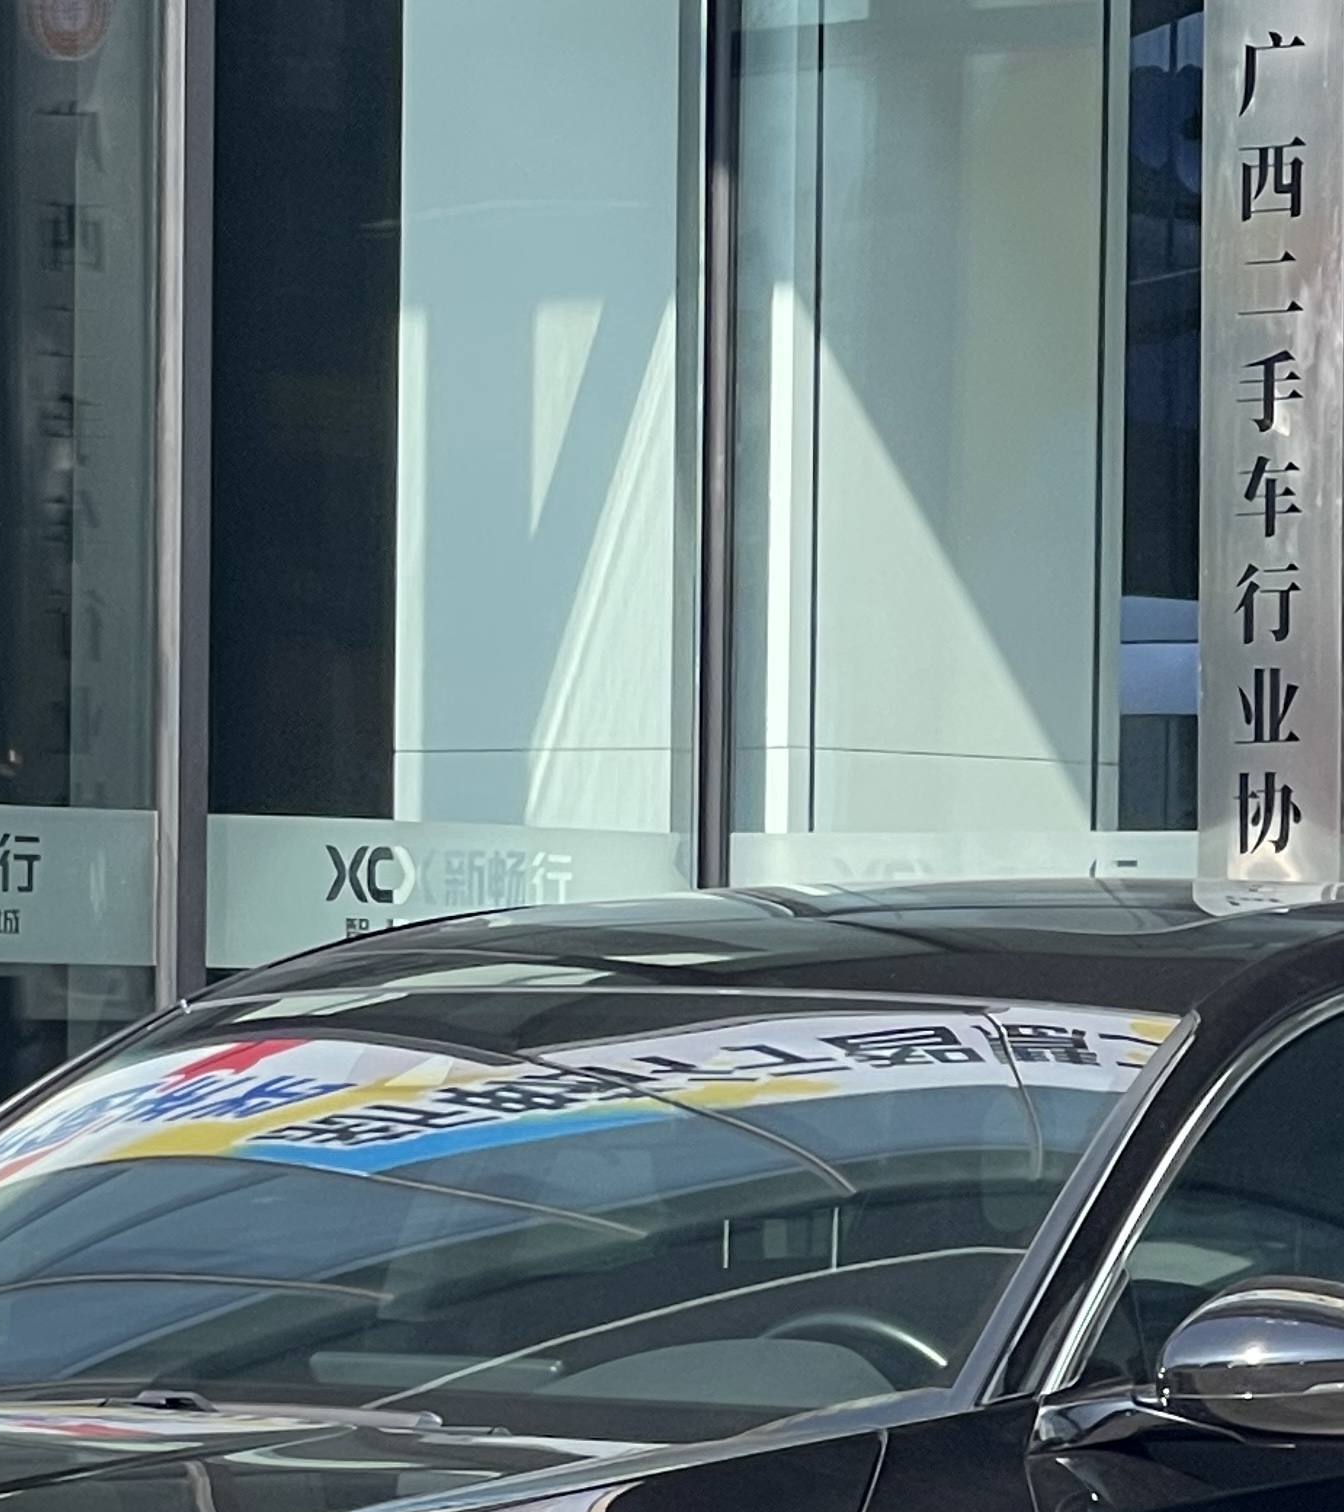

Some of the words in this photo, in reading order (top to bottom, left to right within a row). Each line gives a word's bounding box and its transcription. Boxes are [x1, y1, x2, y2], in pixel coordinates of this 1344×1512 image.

[1232, 31, 1307, 855] 广西二手车行业协
